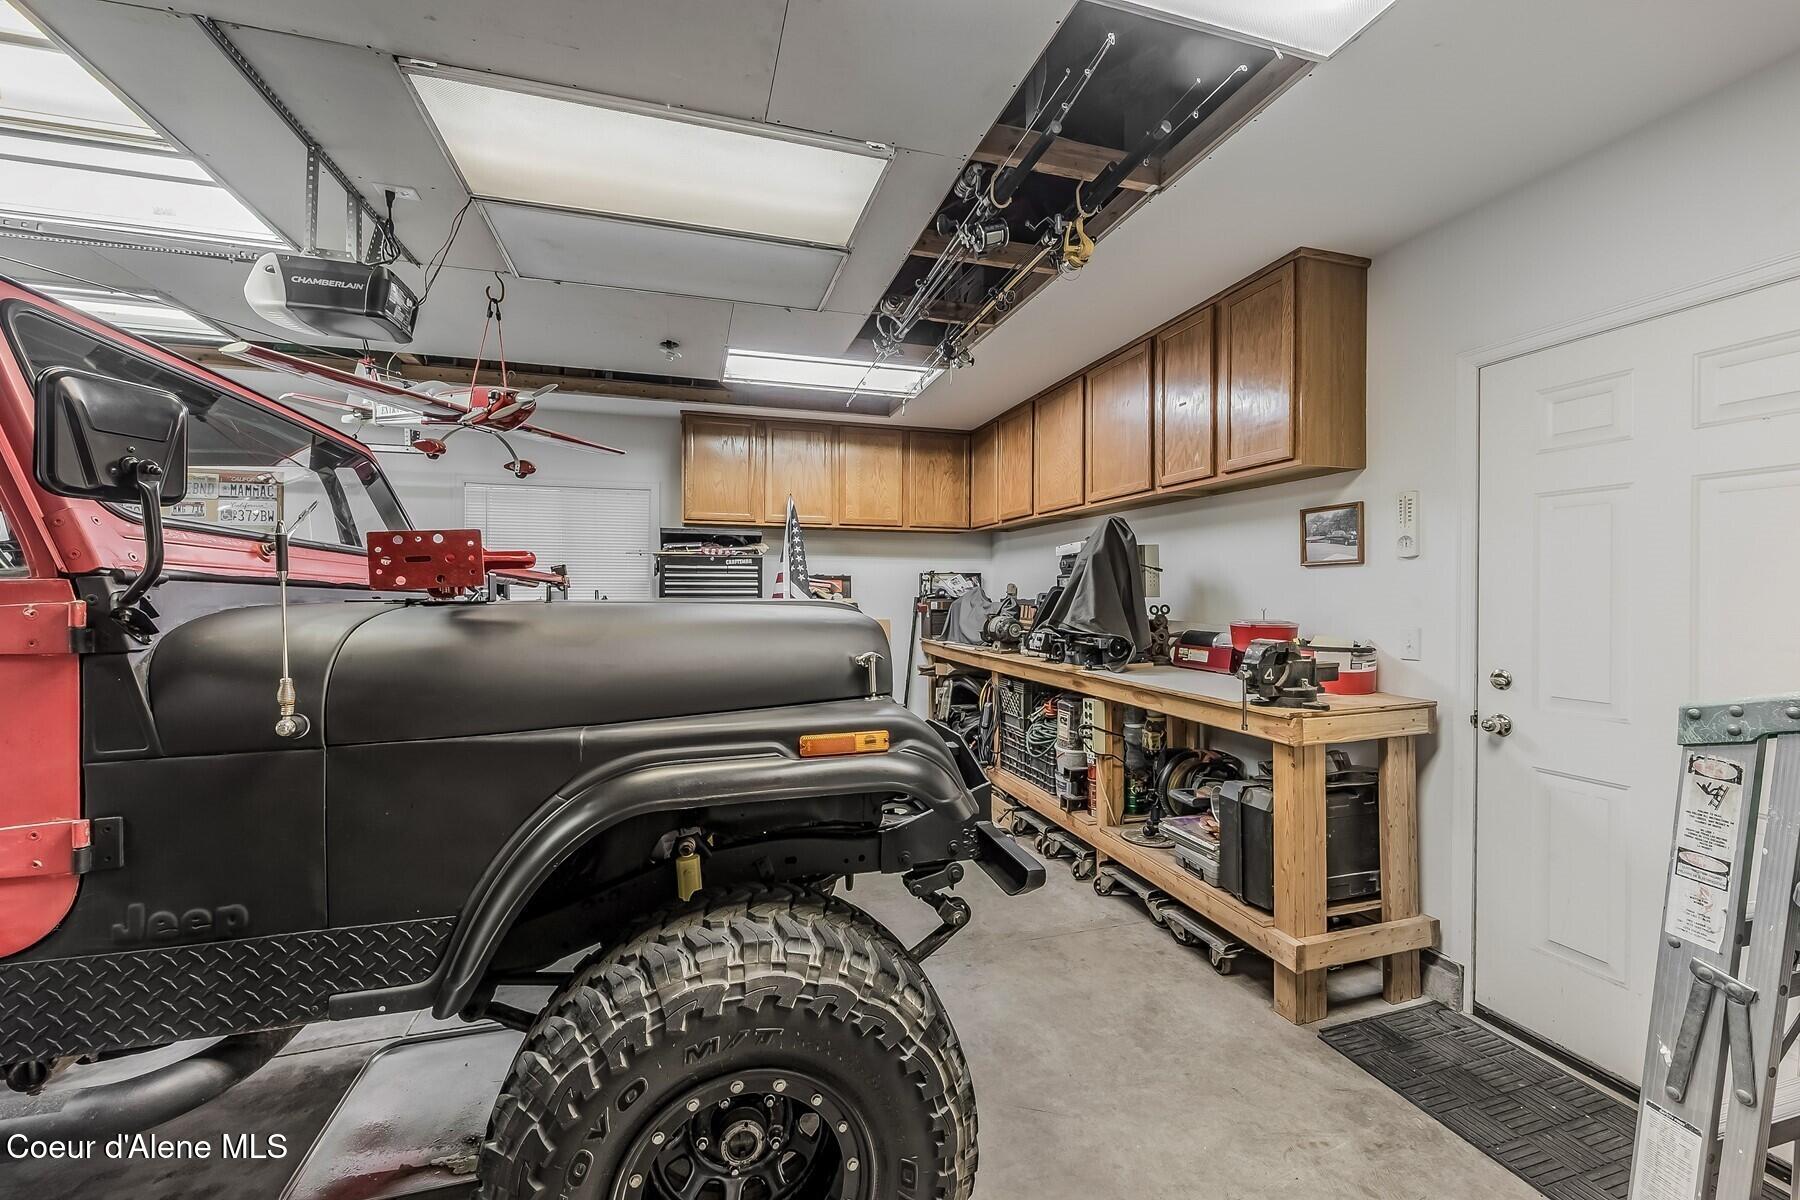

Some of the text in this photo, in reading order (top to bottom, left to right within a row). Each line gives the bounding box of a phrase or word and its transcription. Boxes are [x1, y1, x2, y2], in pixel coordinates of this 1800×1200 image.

[291, 275, 364, 290] CHAMBERLAIN
[1264, 667, 1275, 681] 4
[111, 903, 249, 941] Jeep
[684, 1027, 784, 1064] M/T
